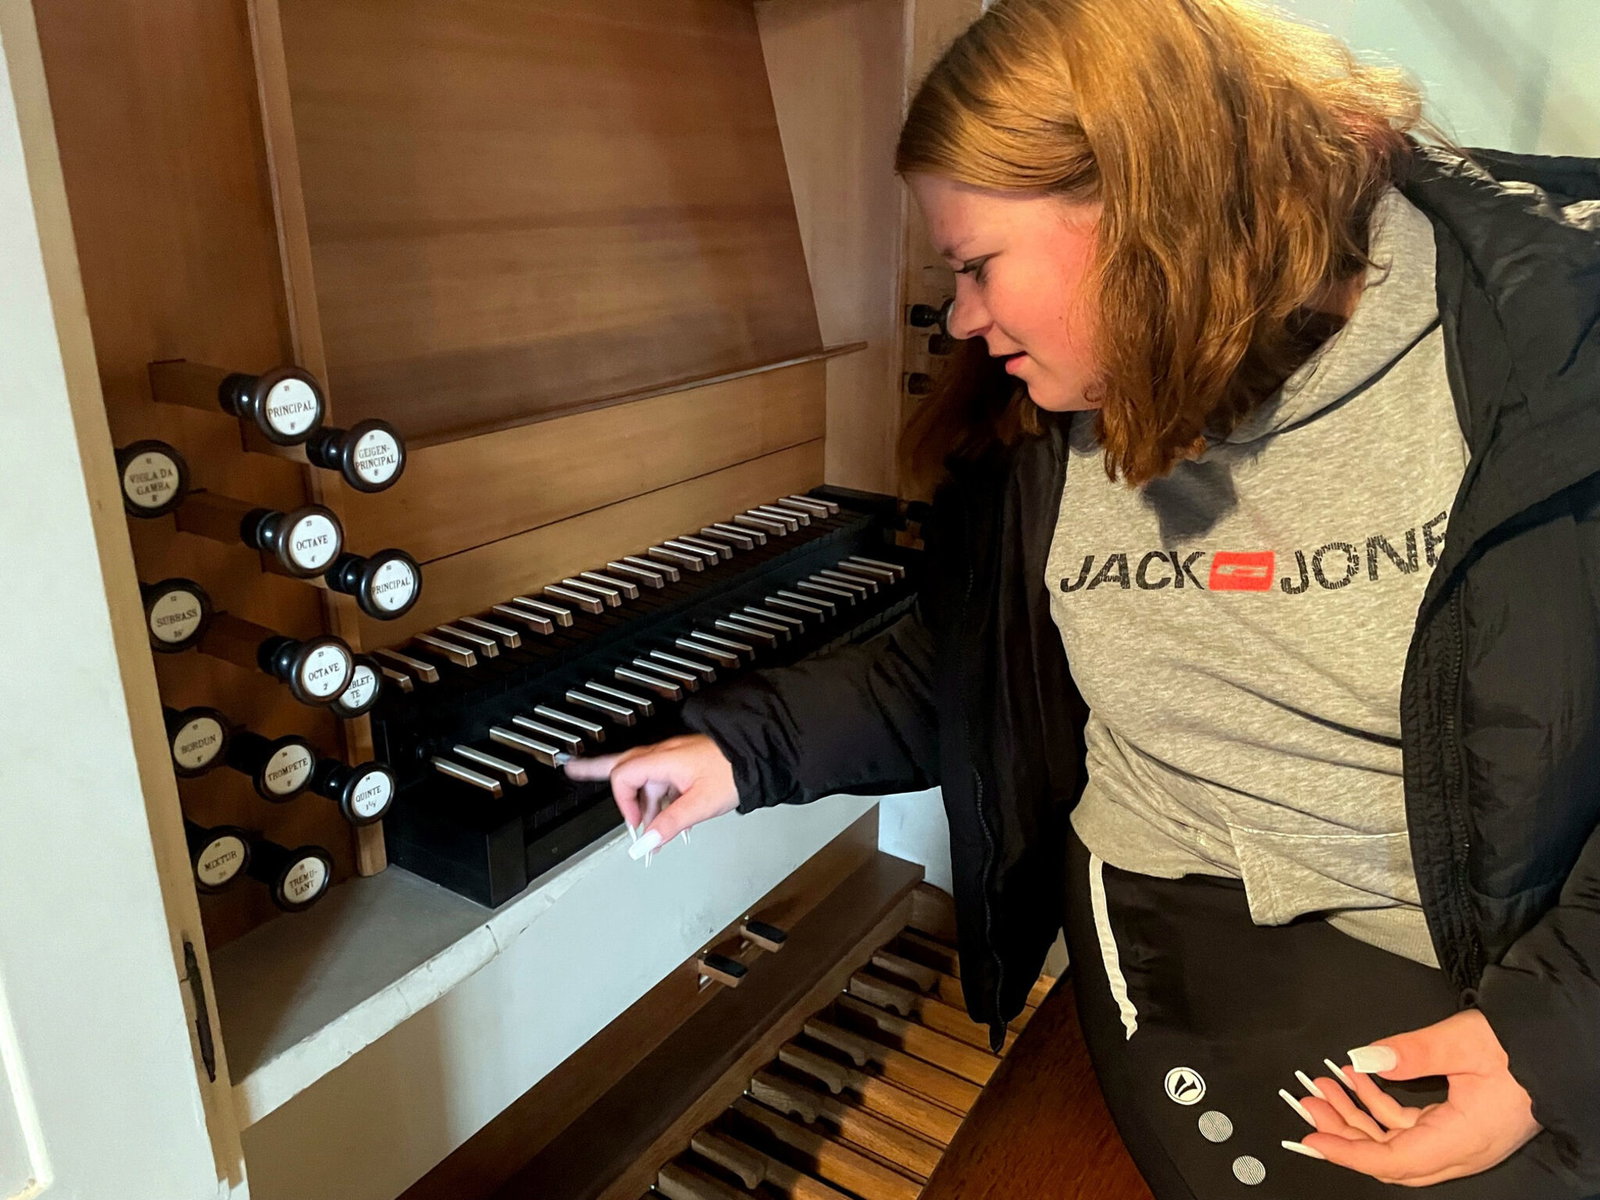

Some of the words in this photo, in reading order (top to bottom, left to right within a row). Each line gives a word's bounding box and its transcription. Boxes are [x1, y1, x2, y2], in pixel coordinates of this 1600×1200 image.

[267, 399, 315, 418] PRINCIPAL
[358, 444, 391, 458] GEIGEN-
[355, 453, 396, 470] PRINCIPAL
[159, 468, 173, 479] DA
[136, 481, 171, 496] GAMBA
[296, 534, 329, 551] OCTAVE
[1060, 551, 1207, 593] JACK
[1280, 510, 1448, 595] JONE
[372, 577, 411, 596] PRINCIPAL
[157, 608, 197, 628] SUBBASS
[308, 662, 341, 682] OCTAVE
[350, 689, 361, 699] TE
[267, 757, 309, 781] TROMPETE
[355, 785, 382, 802] QUINTE
[204, 850, 238, 871] MIXTUR
[289, 869, 318, 890] TREMU-
[294, 879, 315, 897] LANT
